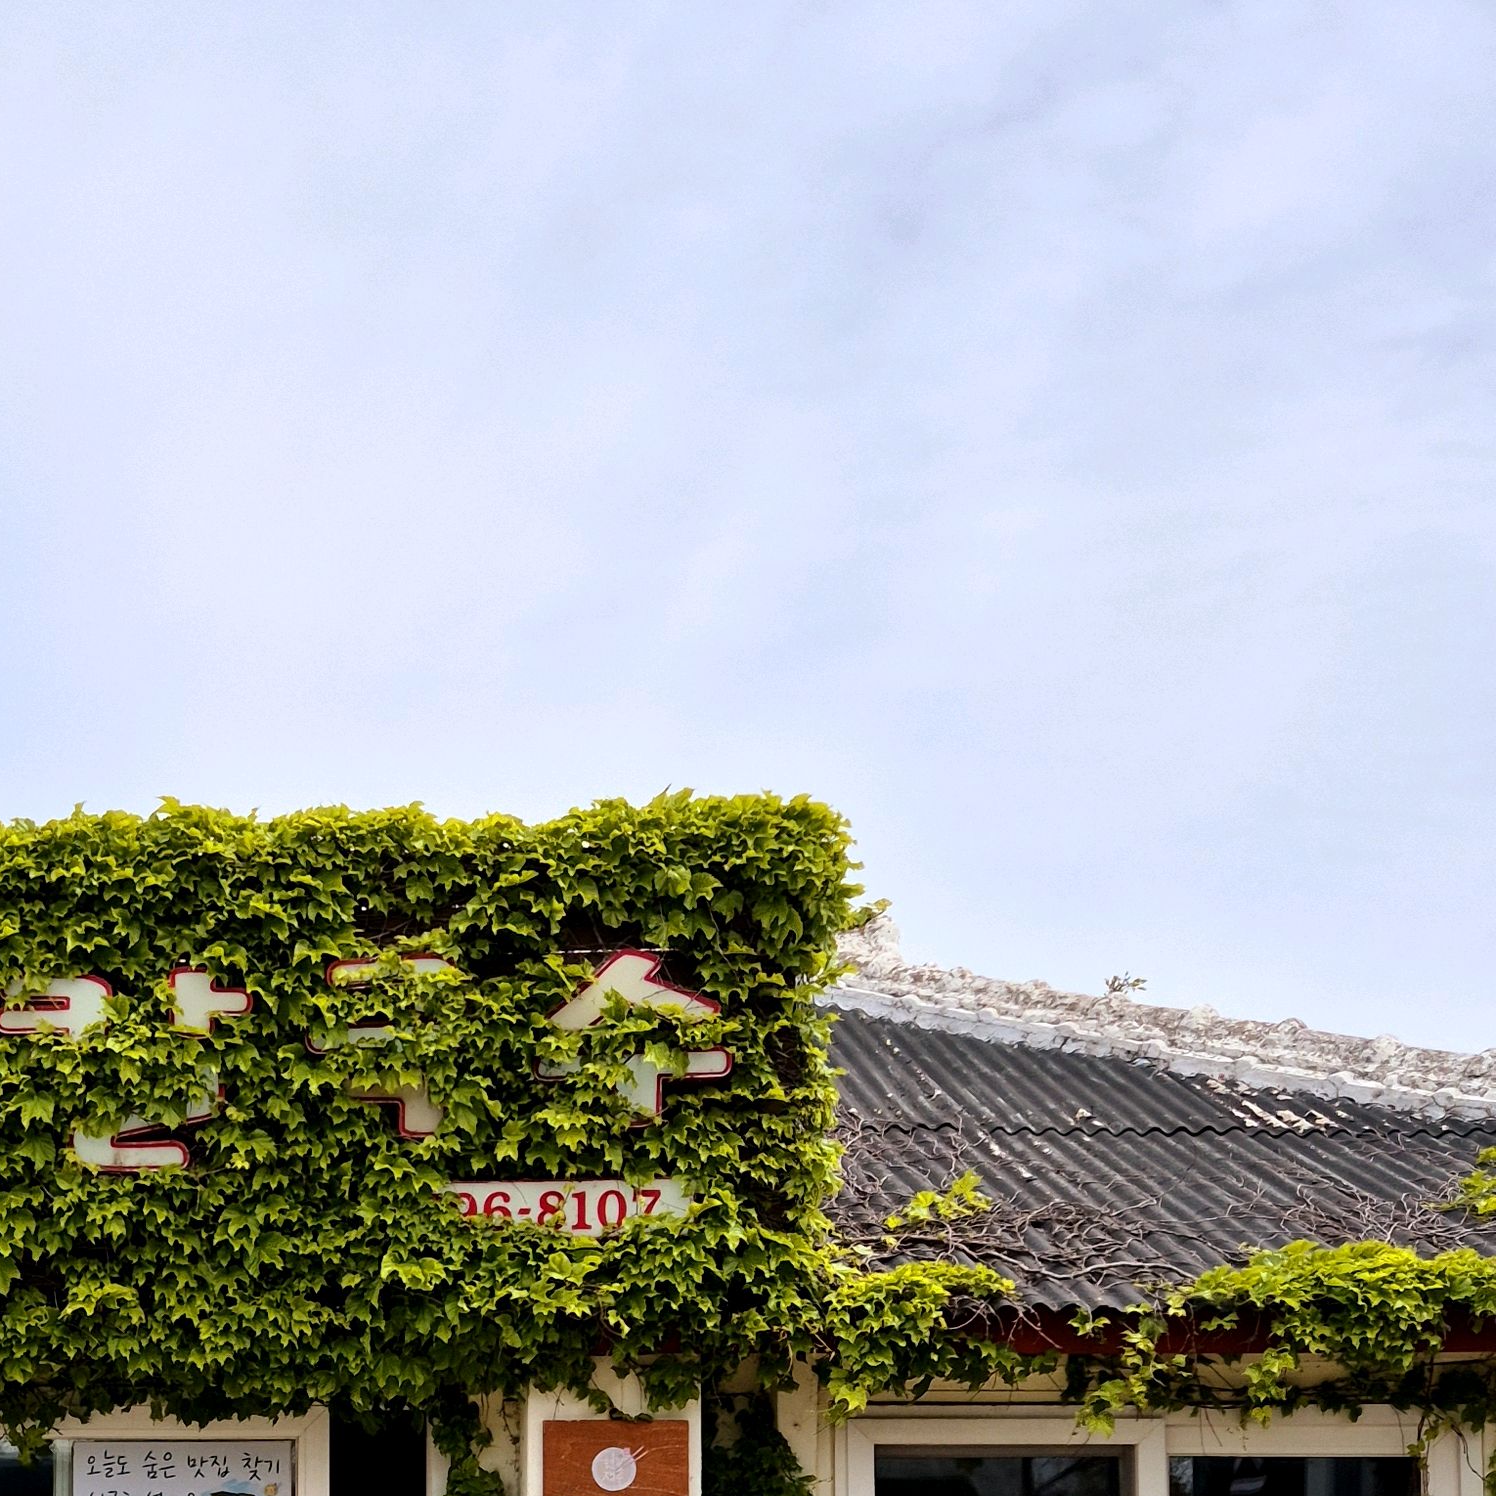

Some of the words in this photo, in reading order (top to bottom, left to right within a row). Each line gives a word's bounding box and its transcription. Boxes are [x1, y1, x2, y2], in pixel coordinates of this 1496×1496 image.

[86, 1450, 131, 1478] 오늘도
[142, 1450, 176, 1479] 숨은
[187, 1454, 230, 1478] 맛집
[241, 1452, 280, 1481] 찾기
